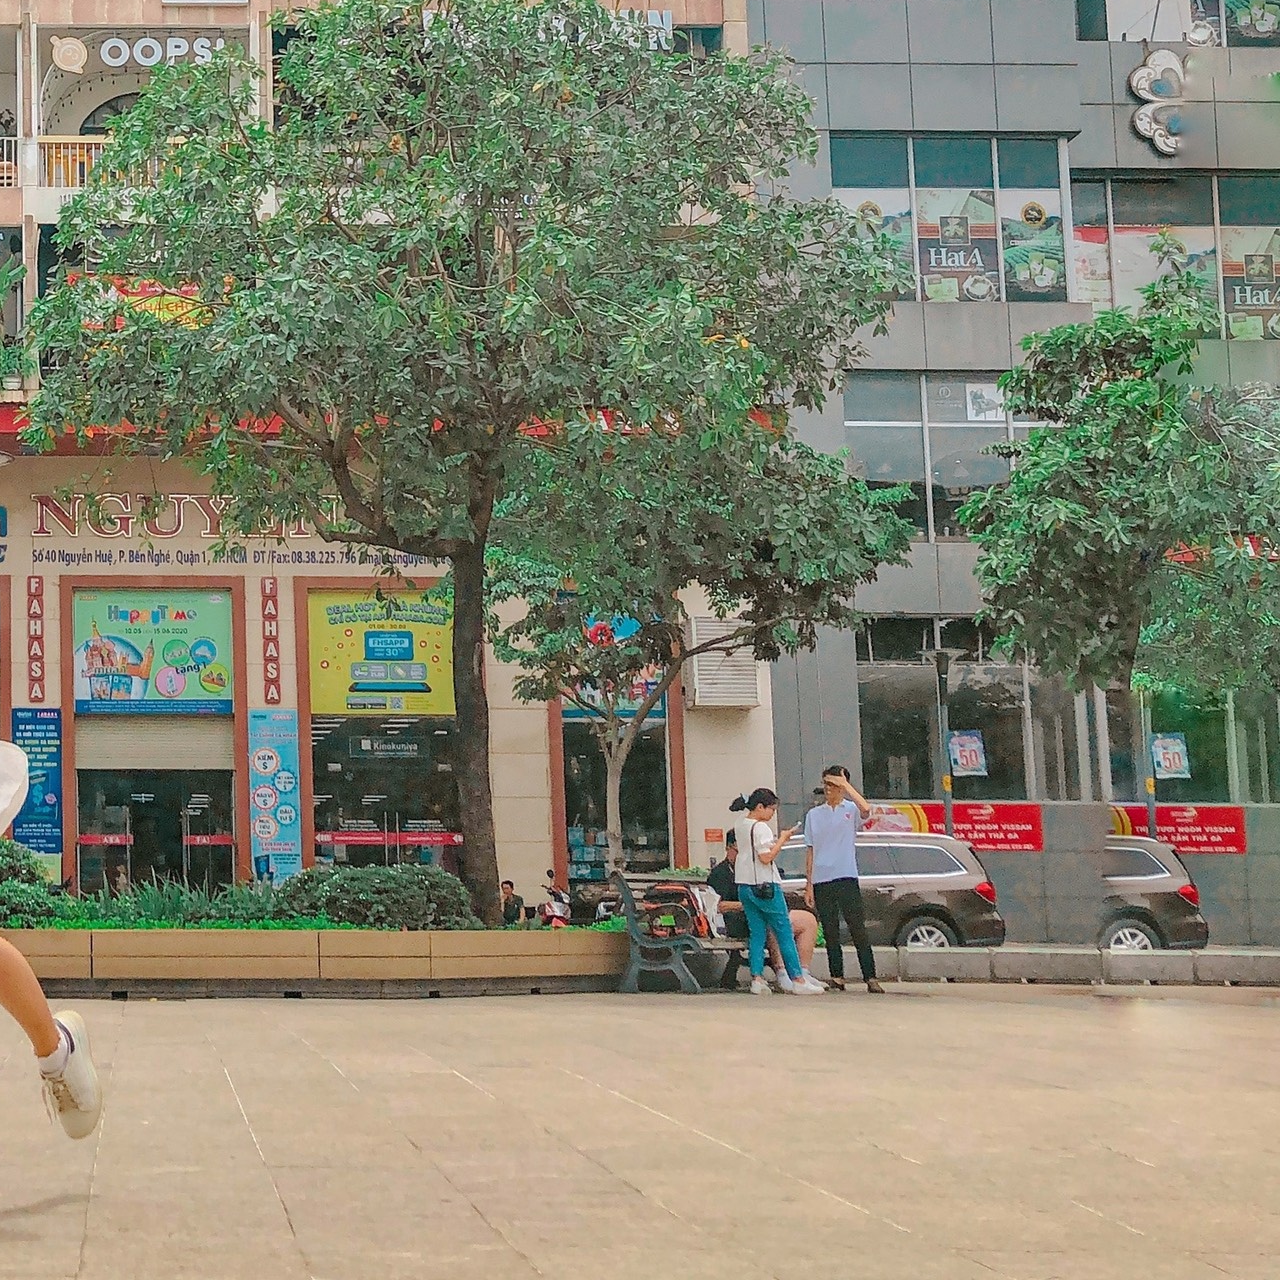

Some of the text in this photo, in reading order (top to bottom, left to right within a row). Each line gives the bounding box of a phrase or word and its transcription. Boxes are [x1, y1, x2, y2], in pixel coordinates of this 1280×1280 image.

[32, 547, 44, 563] Số
[45, 549, 57, 563] 40
[58, 547, 92, 566] Nguyễn
[176, 549, 200, 566] Quận
[291, 550, 356, 564] 08.38.225.796
[30, 579, 43, 701] FAHASA
[265, 579, 278, 701] FAHASA
[373, 742, 418, 751] Kinokuniya
[959, 749, 979, 768] 50
[1162, 752, 1182, 770] 50
